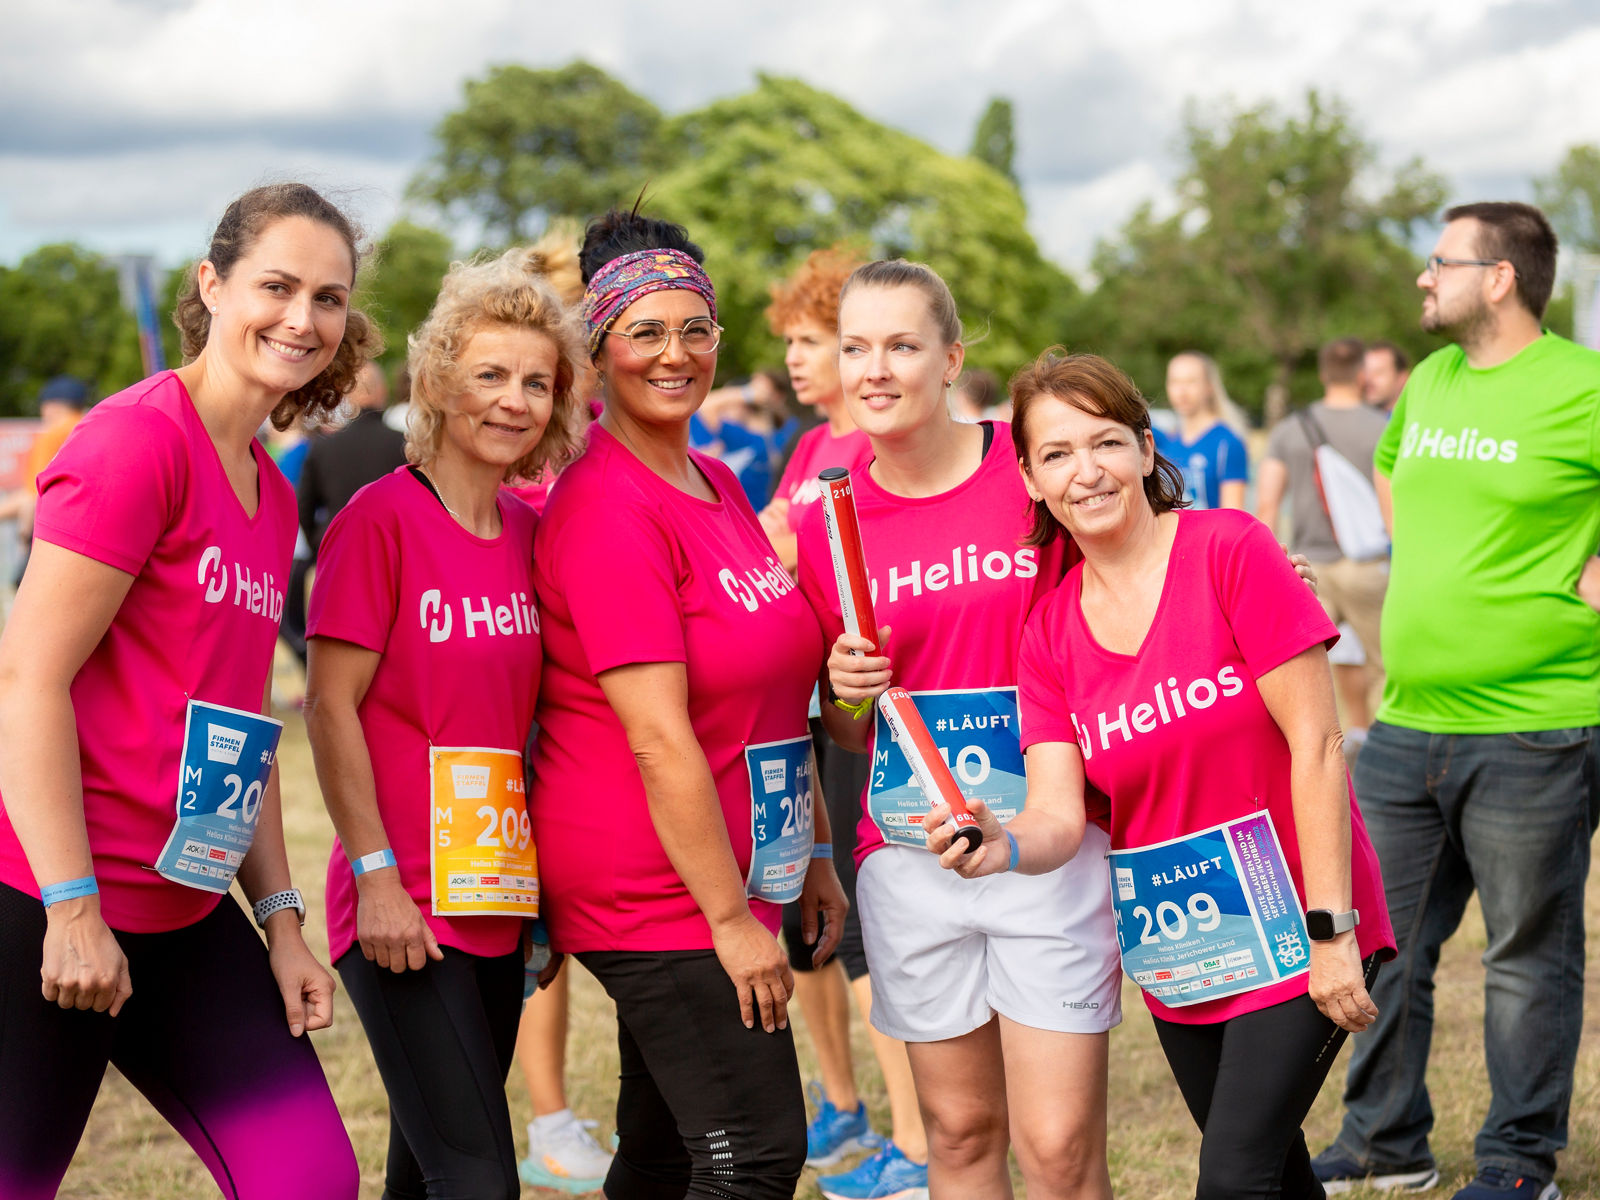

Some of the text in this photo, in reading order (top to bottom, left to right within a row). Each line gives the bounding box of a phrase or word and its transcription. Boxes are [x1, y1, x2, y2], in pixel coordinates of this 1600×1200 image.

[1416, 428, 1518, 463] Helios
[833, 486, 850, 499] 210
[745, 556, 796, 603] Heli
[889, 544, 1038, 603] Helios
[233, 562, 283, 623] Helio
[461, 592, 540, 638] Helio
[1097, 665, 1244, 751] Helios
[936, 714, 1011, 731] #LÄUFT
[210, 740, 240, 753] STAFFEL
[212, 734, 240, 746] FIRMEN
[876, 750, 888, 766] M
[185, 765, 203, 786] M
[874, 771, 885, 787] 2
[184, 790, 196, 810] 2
[216, 773, 266, 826] 20
[436, 807, 453, 825] M
[755, 802, 767, 820] M
[780, 791, 813, 837] 209
[476, 805, 531, 850] 209
[757, 824, 767, 841] 3
[438, 830, 451, 847] 5
[186, 845, 200, 853] AOK
[1151, 856, 1222, 887] #LÄUFT
[1236, 830, 1272, 921] HEUTE #LAUFEN UND IM
[1264, 859, 1275, 880] HALLE
[1260, 873, 1280, 919] SEPTEMBER
[1271, 879, 1282, 898] NACH
[1277, 898, 1288, 915] ALLE
[1132, 892, 1222, 945] 209
[1175, 939, 1201, 949] Kliniken
[1177, 946, 1216, 961] Jerichower
[1218, 939, 1236, 950] Land
[1062, 1001, 1099, 1009] HEAD
